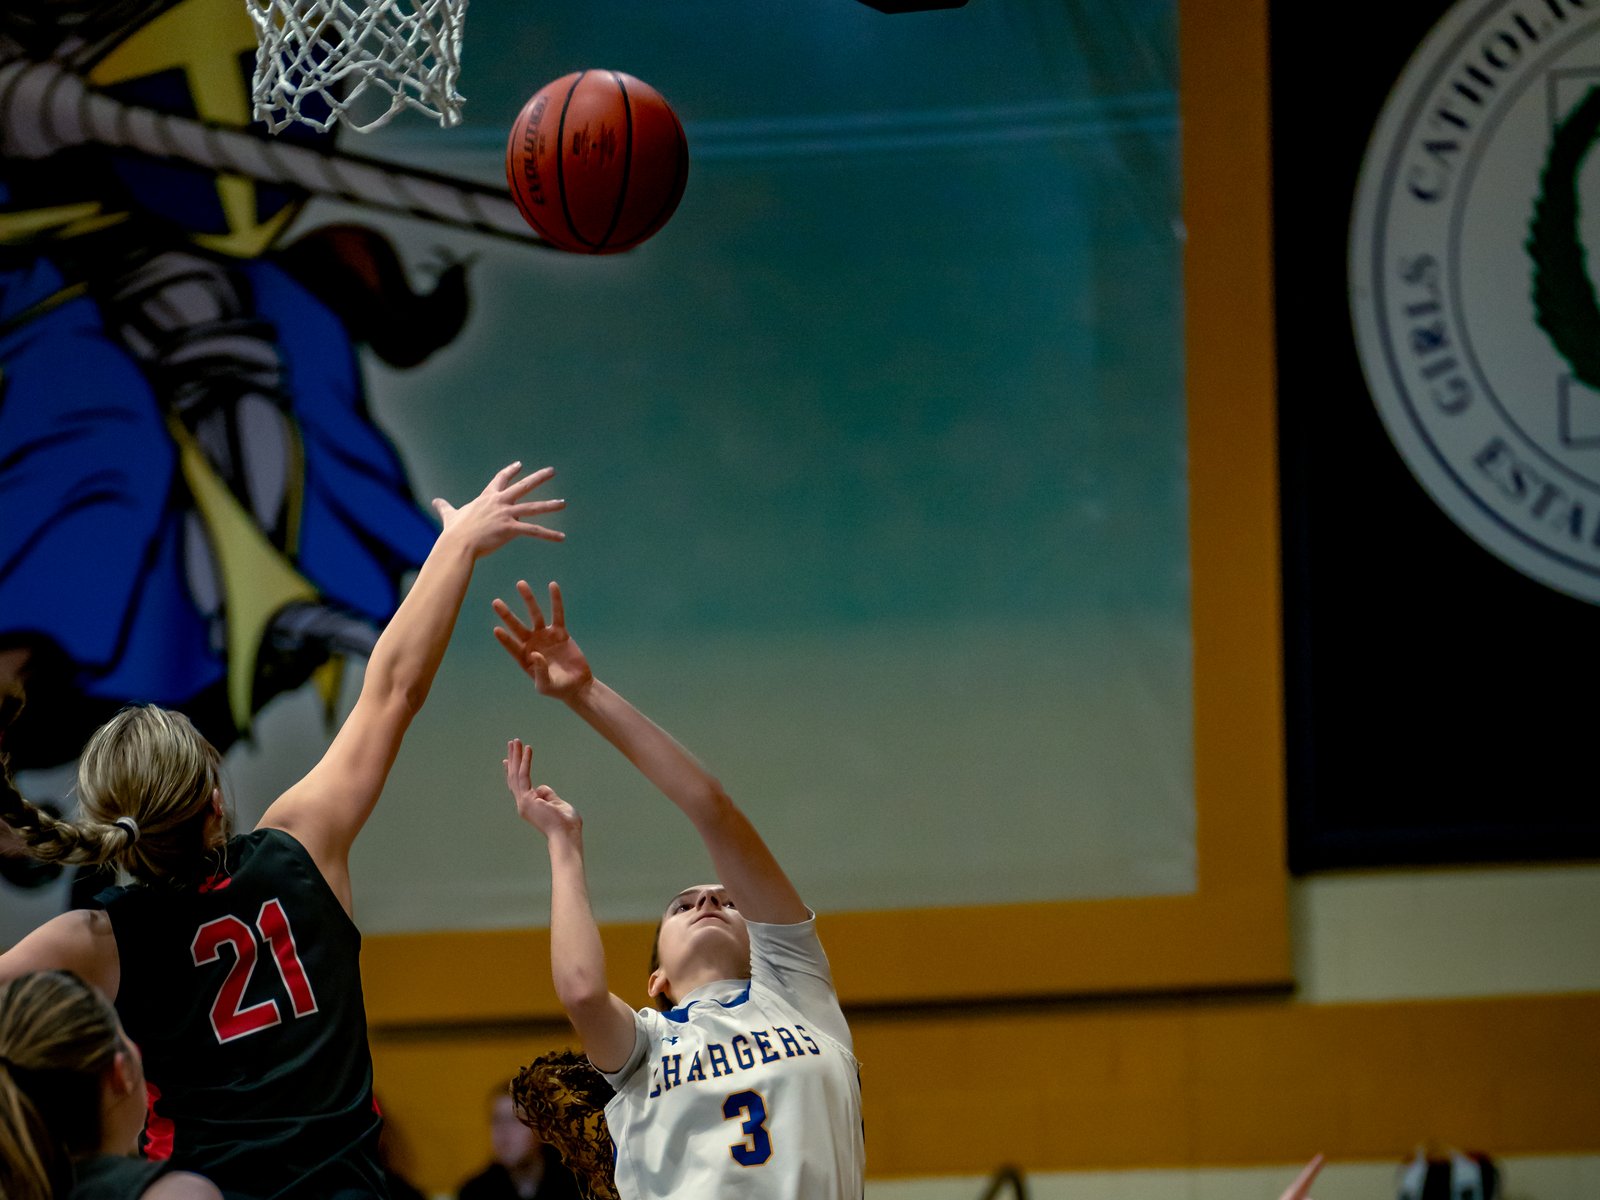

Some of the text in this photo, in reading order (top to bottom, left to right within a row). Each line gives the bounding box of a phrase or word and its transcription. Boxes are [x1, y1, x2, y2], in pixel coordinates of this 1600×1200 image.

[1408, 0, 1583, 203] CATHOLI
[1474, 436, 1600, 550] ESTA
[190, 897, 319, 1045] 21
[649, 1023, 821, 1099] CHARGERS
[722, 1086, 774, 1169] 3
